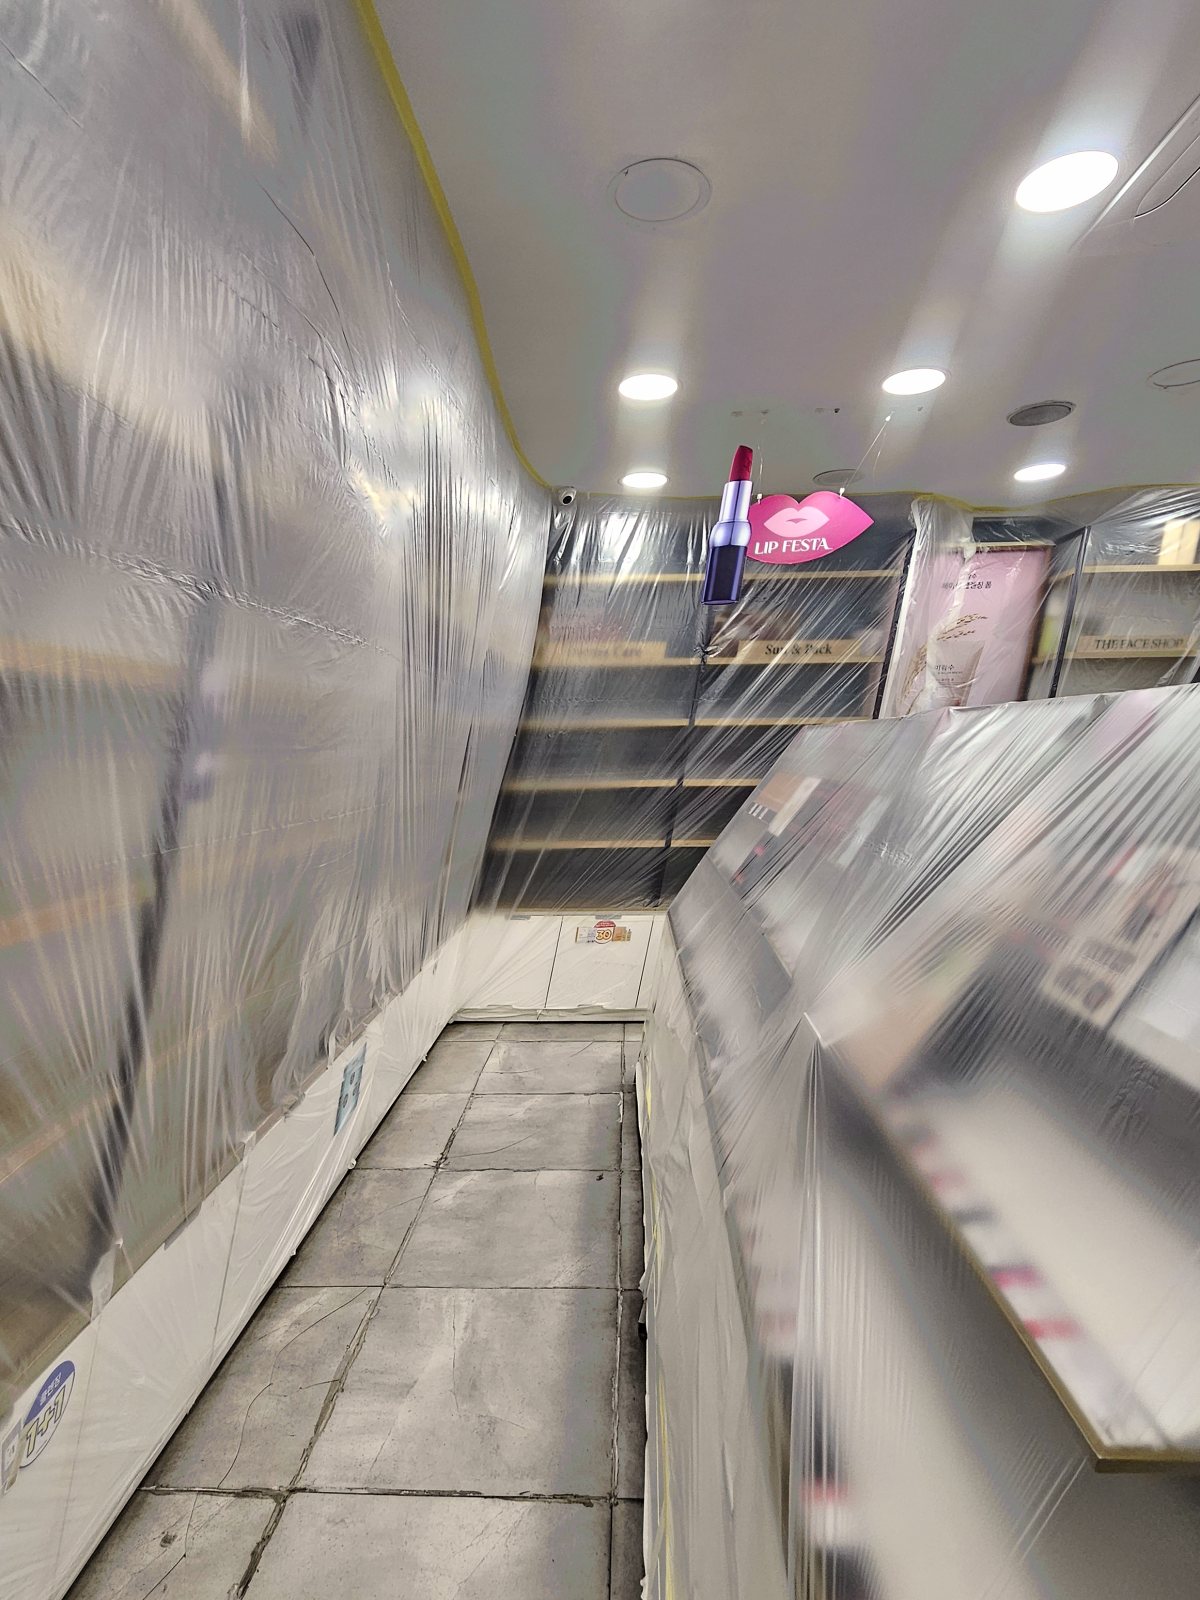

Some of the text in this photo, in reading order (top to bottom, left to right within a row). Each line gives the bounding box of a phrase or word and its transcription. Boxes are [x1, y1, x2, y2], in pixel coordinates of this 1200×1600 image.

[754, 537, 833, 555] LIP FESTA
[1095, 639, 1118, 650] THE
[1119, 638, 1149, 650] FACE
[595, 929, 612, 940] 30
[26, 1385, 65, 1458] 1+1
